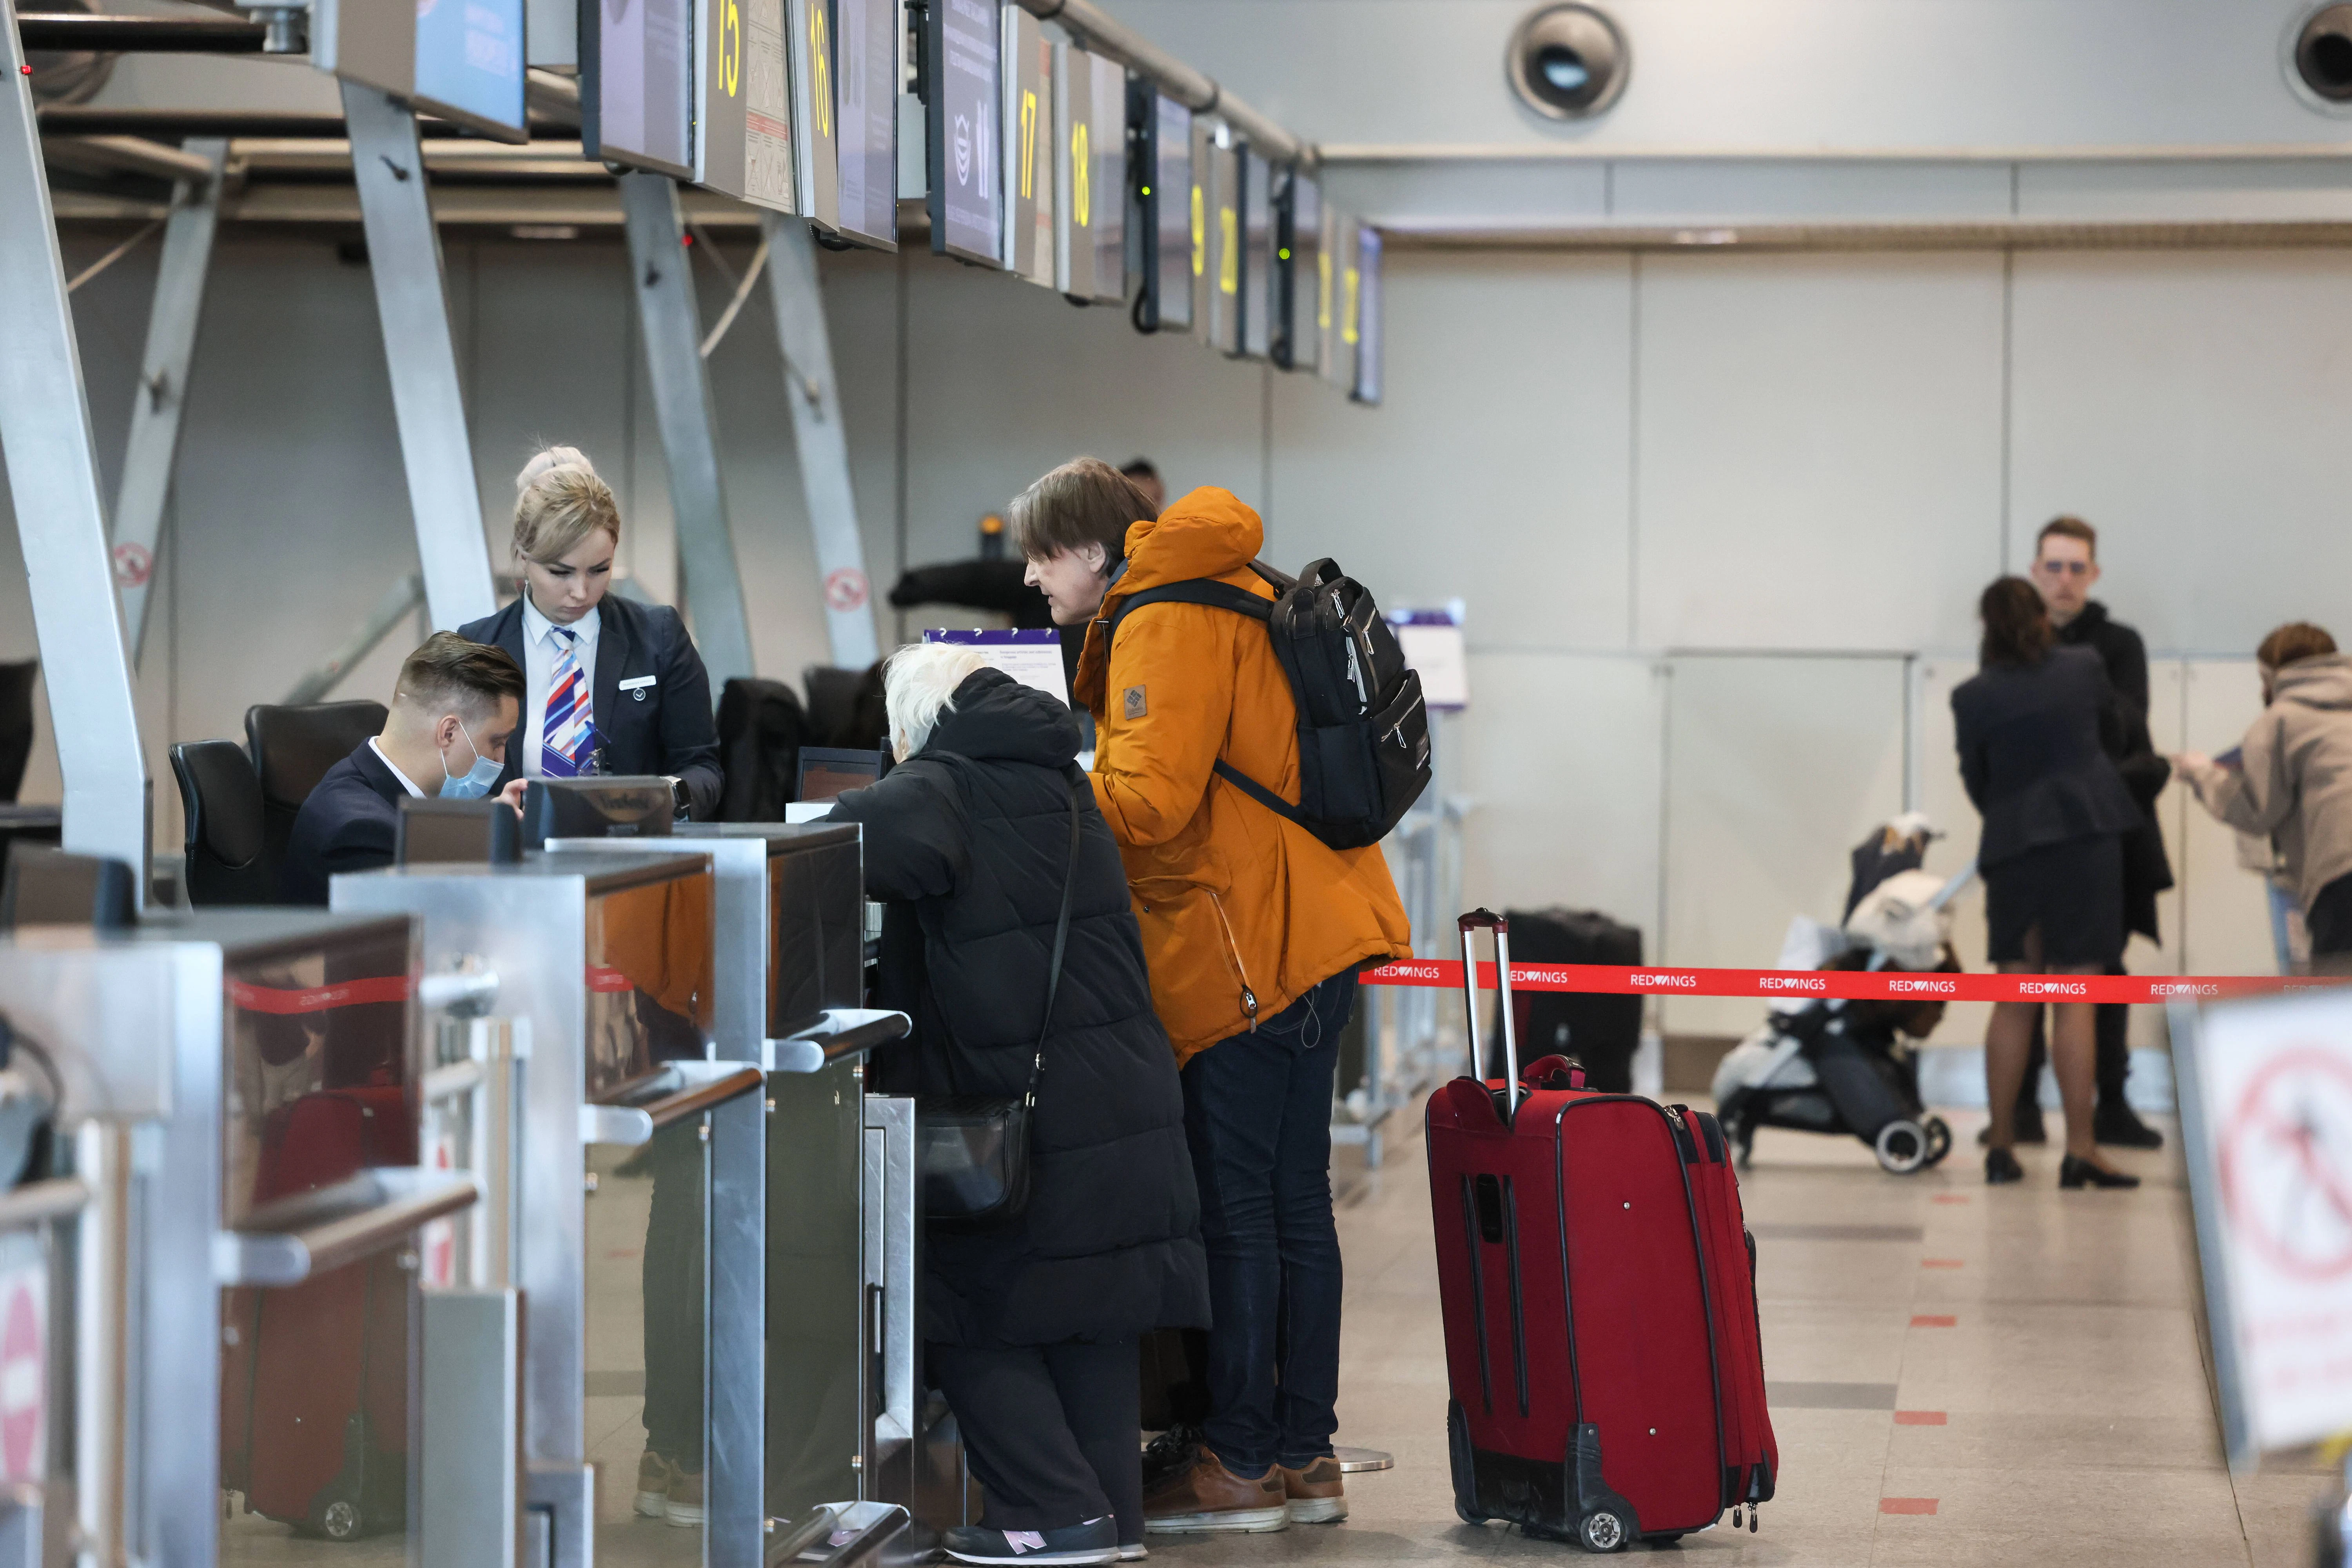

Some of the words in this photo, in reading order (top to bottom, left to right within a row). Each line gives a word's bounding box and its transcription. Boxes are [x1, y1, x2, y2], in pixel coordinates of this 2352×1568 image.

[718, 0, 740, 97] 15
[810, 2, 828, 138] 16
[1021, 89, 1036, 199] 17
[1071, 121, 1089, 227] 18
[1510, 970, 1568, 984] EDWINGS
